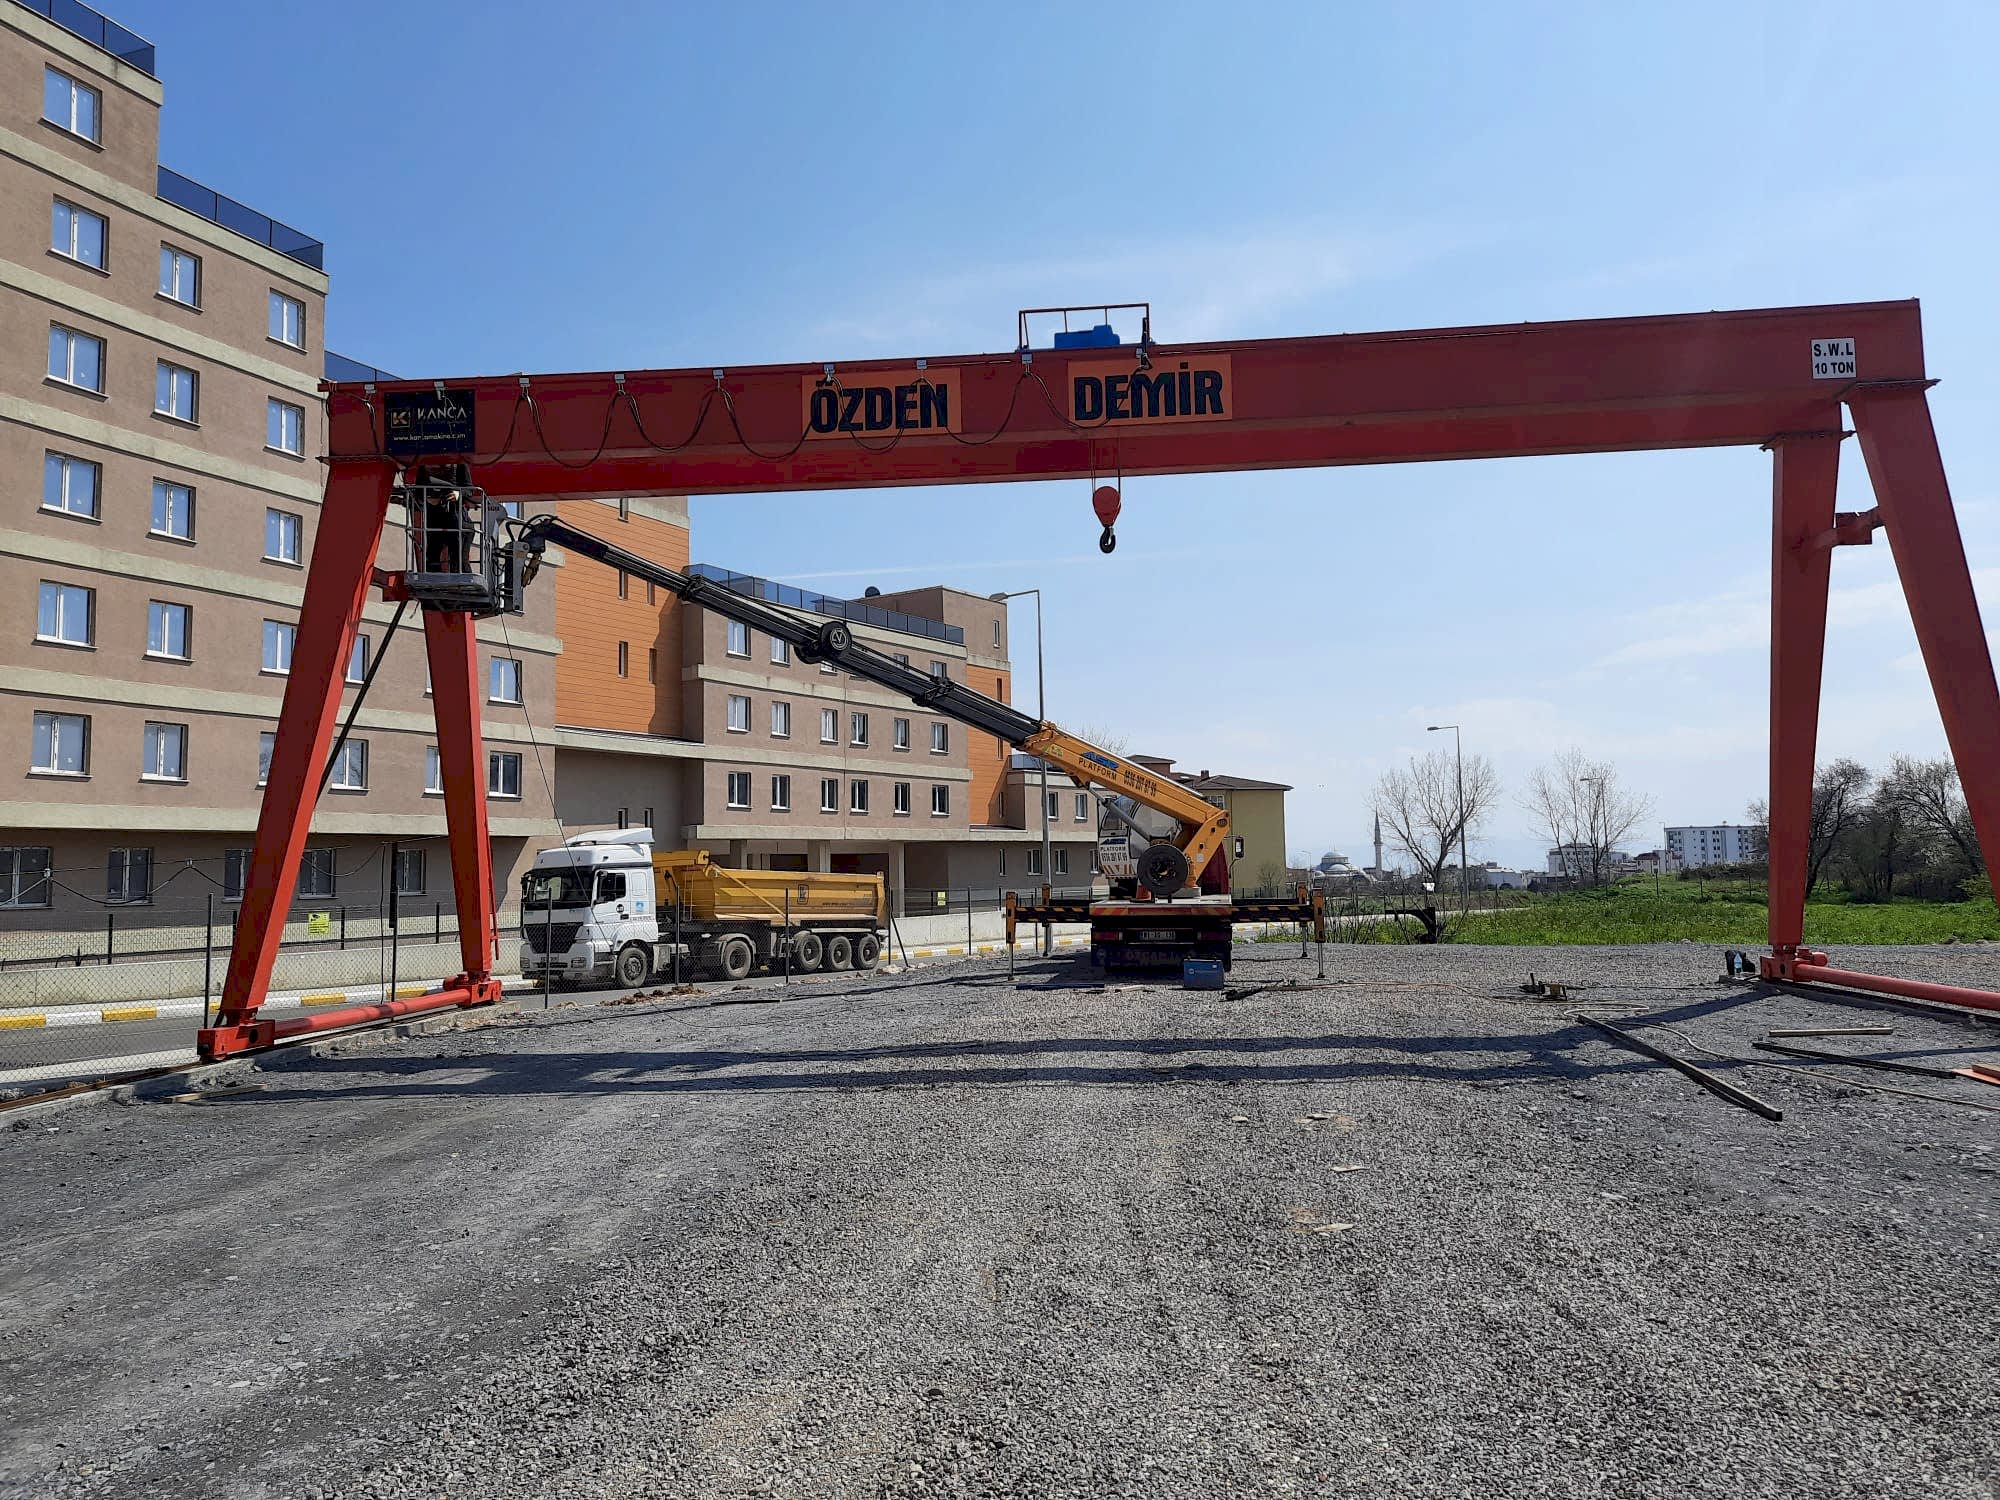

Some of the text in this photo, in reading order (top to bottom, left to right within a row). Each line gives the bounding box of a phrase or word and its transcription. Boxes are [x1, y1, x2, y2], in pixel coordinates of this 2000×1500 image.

[1813, 342, 1853, 357] S.W.L
[1814, 361, 1854, 375] 10 TON
[809, 362, 1225, 434] ÖZDEN DEMİR
[1078, 757, 1118, 781] PLATFORM
